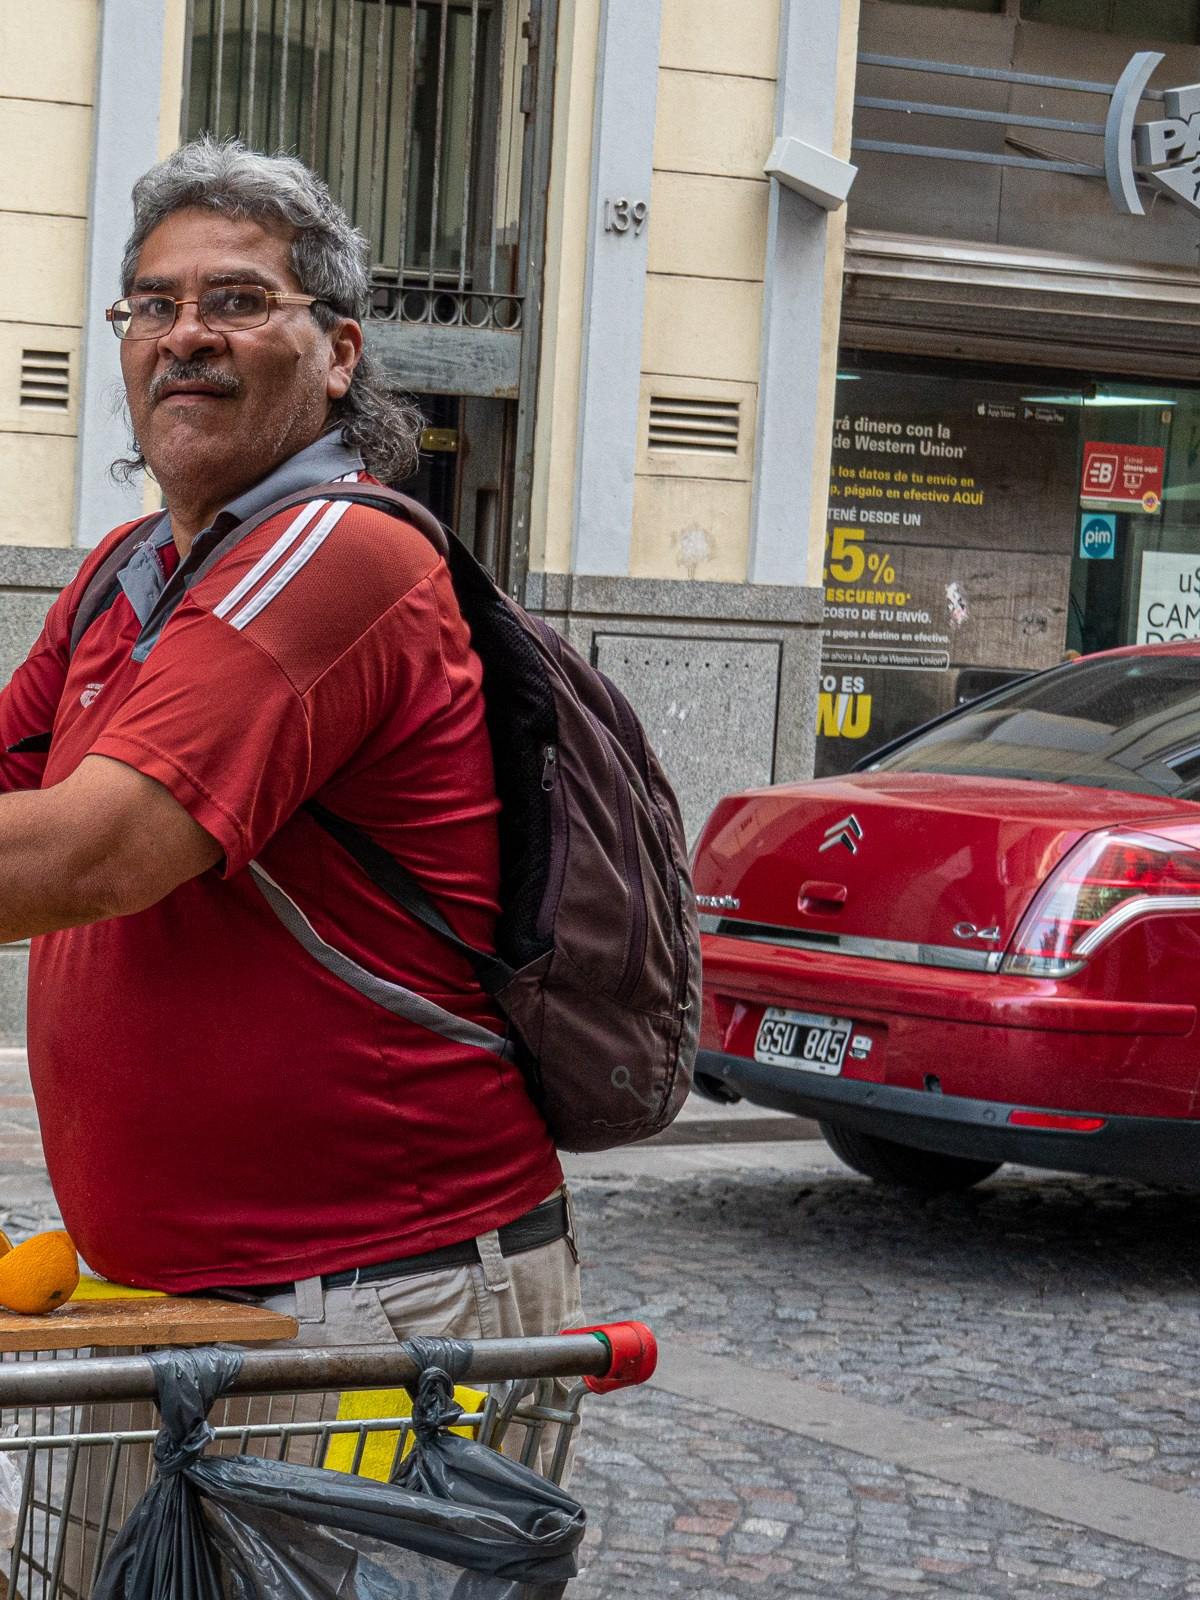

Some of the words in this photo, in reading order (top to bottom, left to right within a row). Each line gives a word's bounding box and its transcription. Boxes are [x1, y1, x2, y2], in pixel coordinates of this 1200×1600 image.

[604, 198, 648, 236] 139
[854, 416, 901, 434] dinero
[906, 423, 934, 438] con
[938, 423, 951, 440] la
[832, 434, 850, 449] de
[854, 435, 915, 454] Western
[838, 465, 855, 478] los
[859, 467, 891, 481] datos
[894, 469, 908, 483] de
[912, 471, 923, 484] tu
[961, 478, 974, 488] en
[844, 484, 883, 499] págalo
[886, 489, 900, 499] en
[903, 487, 950, 503] efectivo
[952, 490, 984, 505] AQUÍ
[860, 509, 900, 525] DESDE
[903, 513, 921, 526] UN
[1085, 526, 1111, 548] pim
[822, 606, 859, 620] COSTO
[862, 608, 877, 620] DE
[880, 610, 894, 622] TU
[896, 609, 932, 624] ENVÍO.
[833, 629, 859, 639] pagos
[867, 629, 899, 641] destino
[901, 632, 912, 641] en
[831, 652, 853, 662] ahora
[861, 651, 878, 665] App
[888, 653, 919, 665] Western
[841, 676, 865, 694] ES
[953, 921, 1000, 941] C4
[758, 1021, 799, 1055] GSU
[803, 1028, 845, 1064] 845
